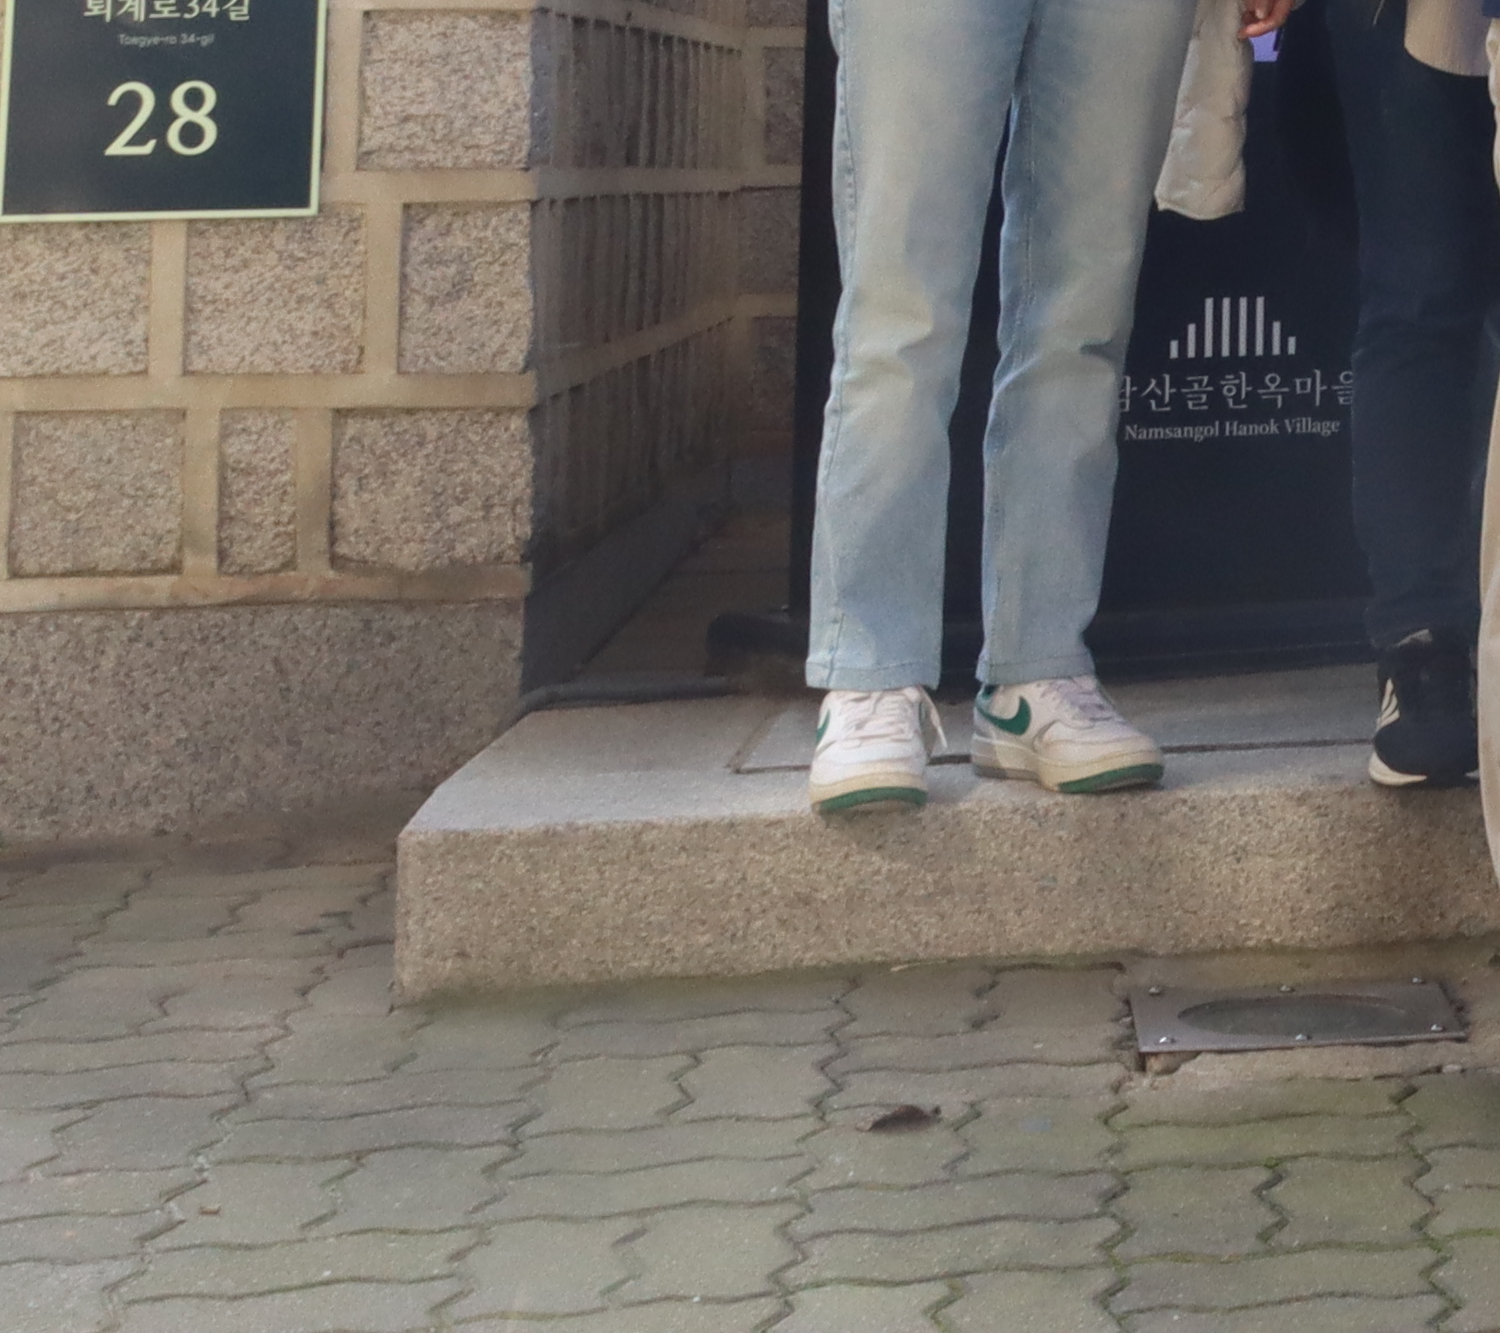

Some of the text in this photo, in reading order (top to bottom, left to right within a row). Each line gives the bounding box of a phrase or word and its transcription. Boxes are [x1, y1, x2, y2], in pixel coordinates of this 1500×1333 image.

[104, 80, 218, 156] 28
[1124, 415, 1342, 443] Namsangol Hanok Village
